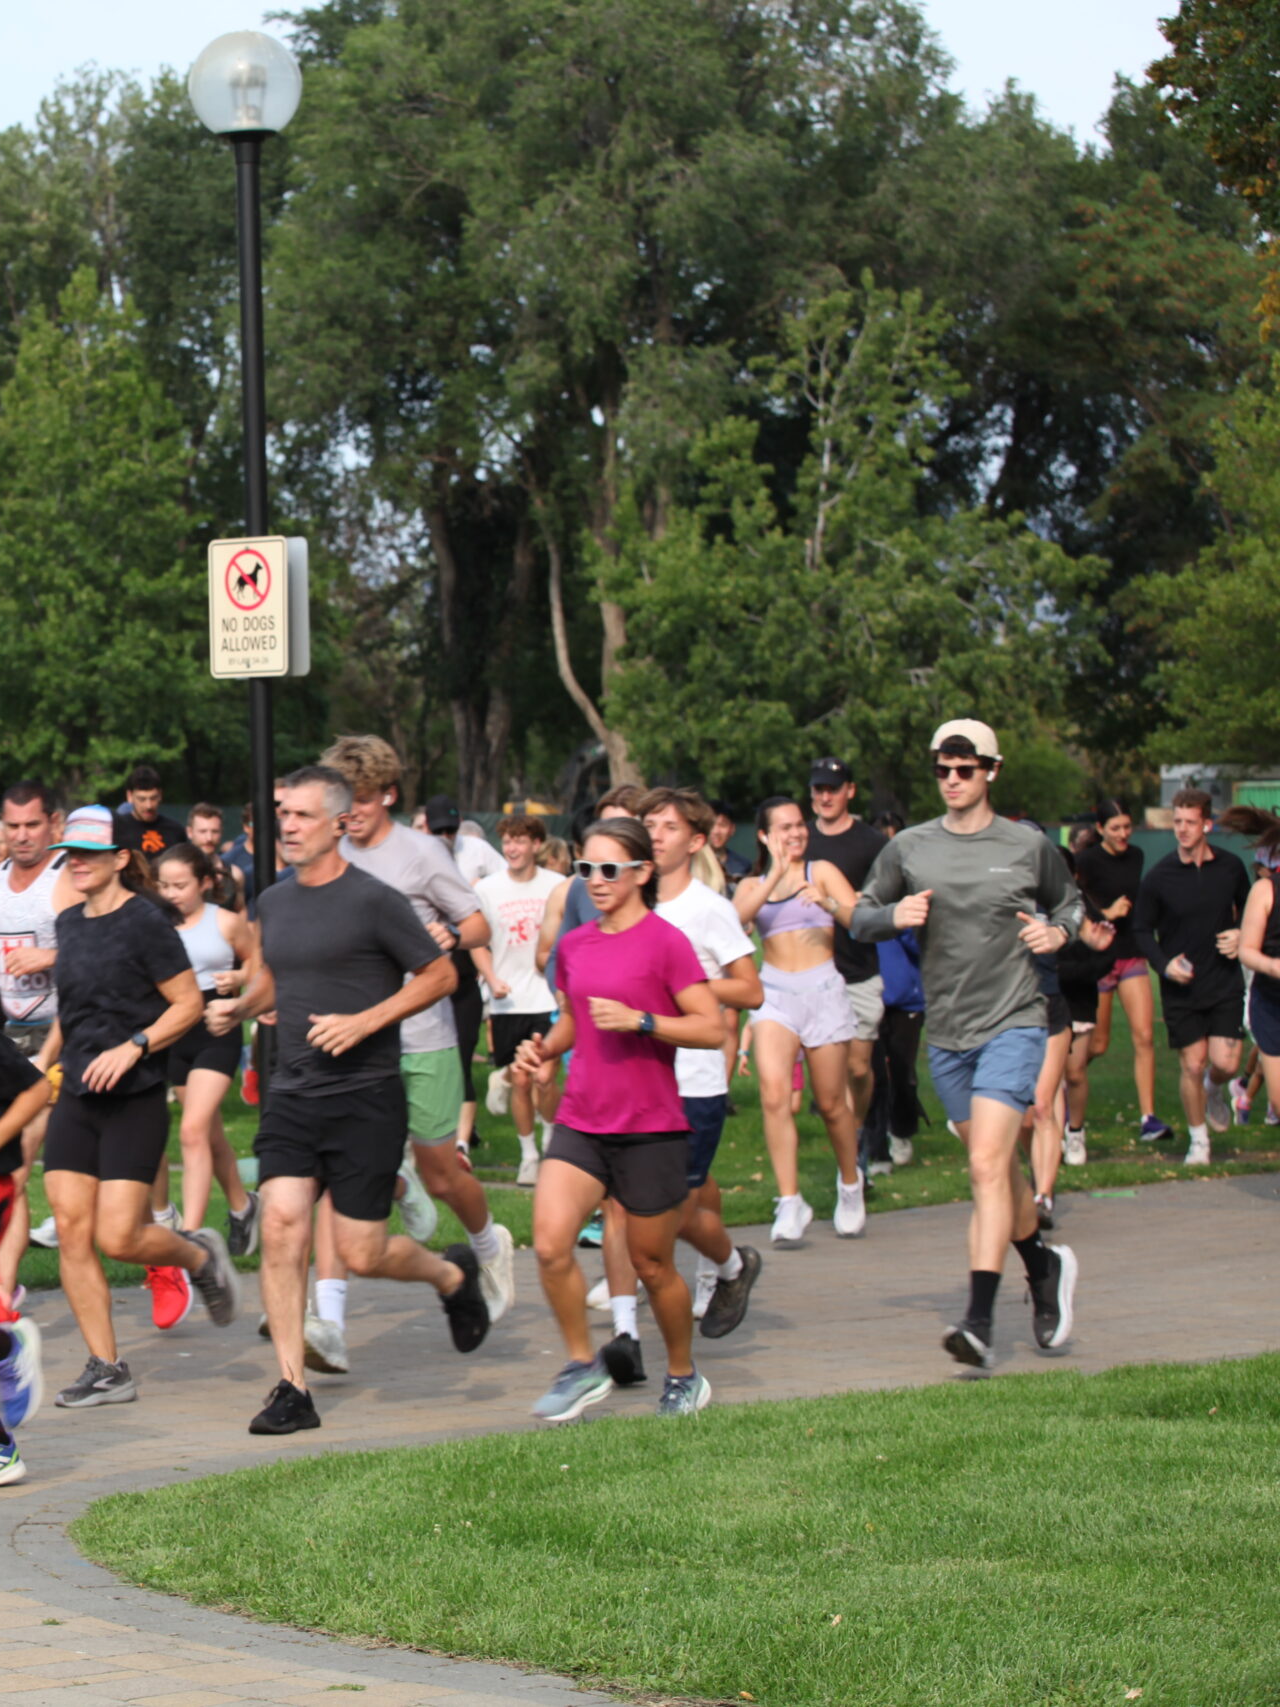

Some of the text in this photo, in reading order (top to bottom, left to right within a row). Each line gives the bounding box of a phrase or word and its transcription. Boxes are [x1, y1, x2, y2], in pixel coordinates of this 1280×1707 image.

[222, 615, 275, 632] NO DOGS
[221, 635, 277, 651] ALLOWED
